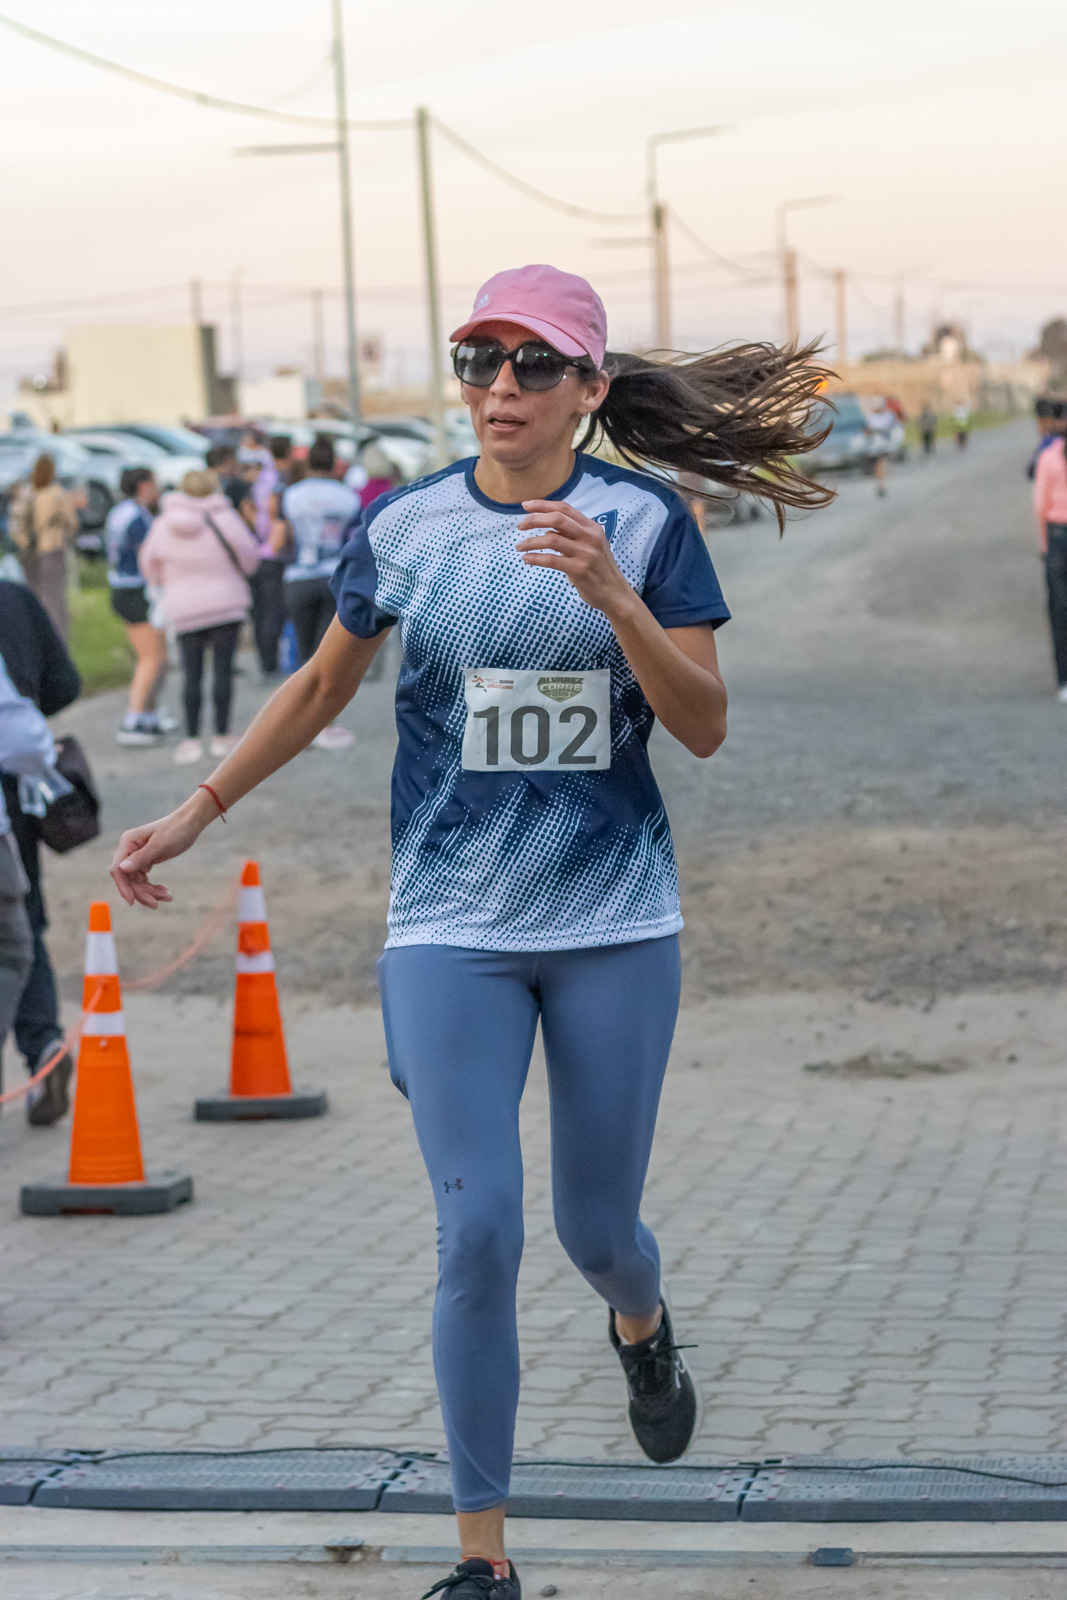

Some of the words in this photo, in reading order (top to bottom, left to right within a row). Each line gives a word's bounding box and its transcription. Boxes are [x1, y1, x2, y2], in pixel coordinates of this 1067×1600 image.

[539, 676, 584, 684] ALVAREZ
[539, 683, 583, 691] CORRE
[473, 705, 598, 765] 102
